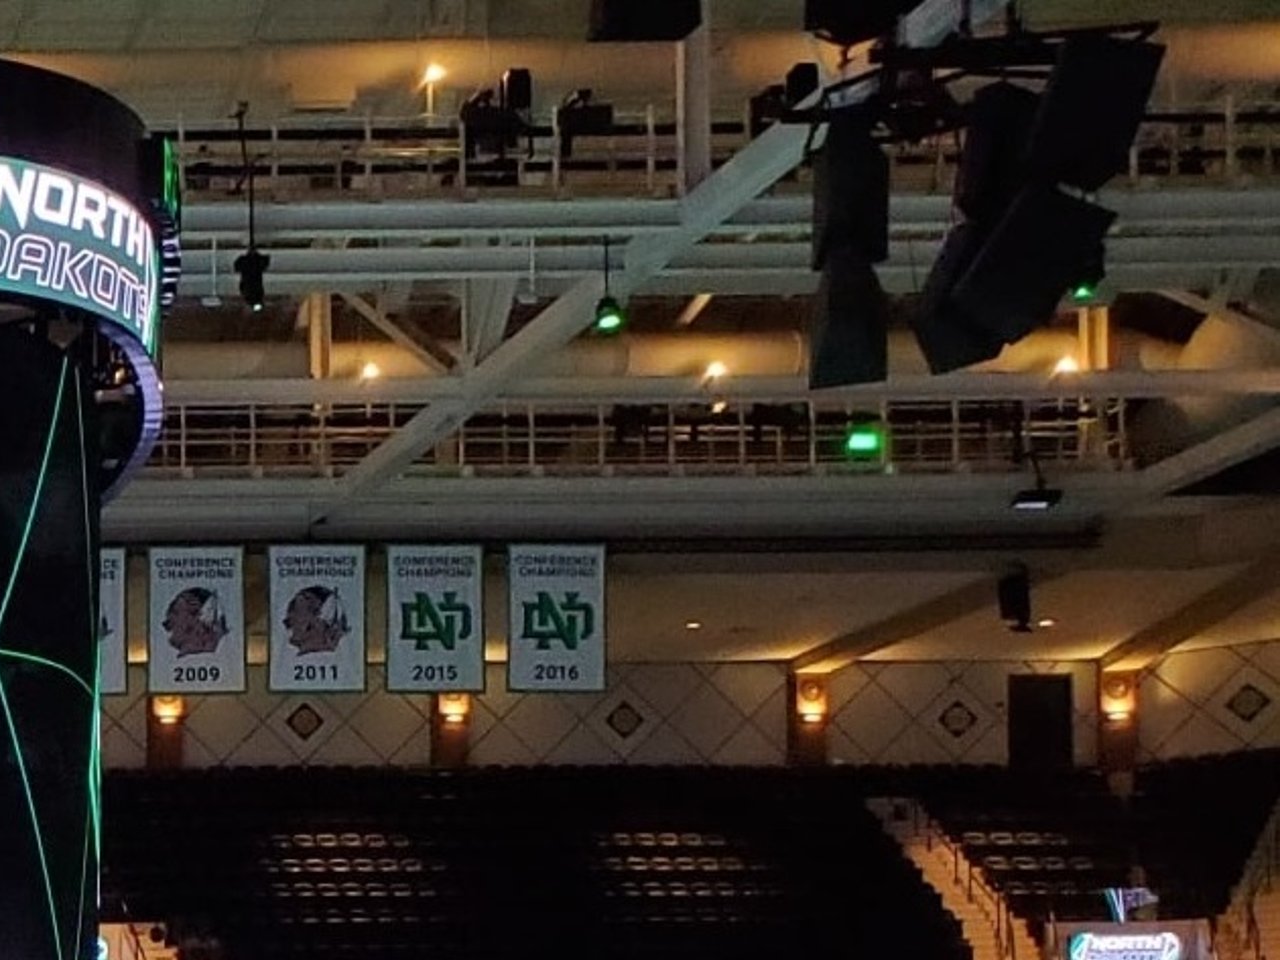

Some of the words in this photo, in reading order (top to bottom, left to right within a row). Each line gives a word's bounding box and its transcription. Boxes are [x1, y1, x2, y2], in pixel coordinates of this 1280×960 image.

[155, 558, 236, 568] CONFERENCE
[275, 556, 357, 567] CONFERENCE
[393, 555, 475, 566] CONFERENCE
[514, 555, 596, 567] CONFERENCE
[158, 569, 235, 579] CHAMPIONS
[278, 567, 355, 578] CHAMPIONS
[397, 567, 472, 578] CHAMPIONS
[519, 567, 594, 578] CHAMPIONS
[174, 667, 220, 682] 2009
[293, 666, 338, 681] 2011
[412, 666, 458, 681] 2015
[534, 665, 579, 680] 2016
